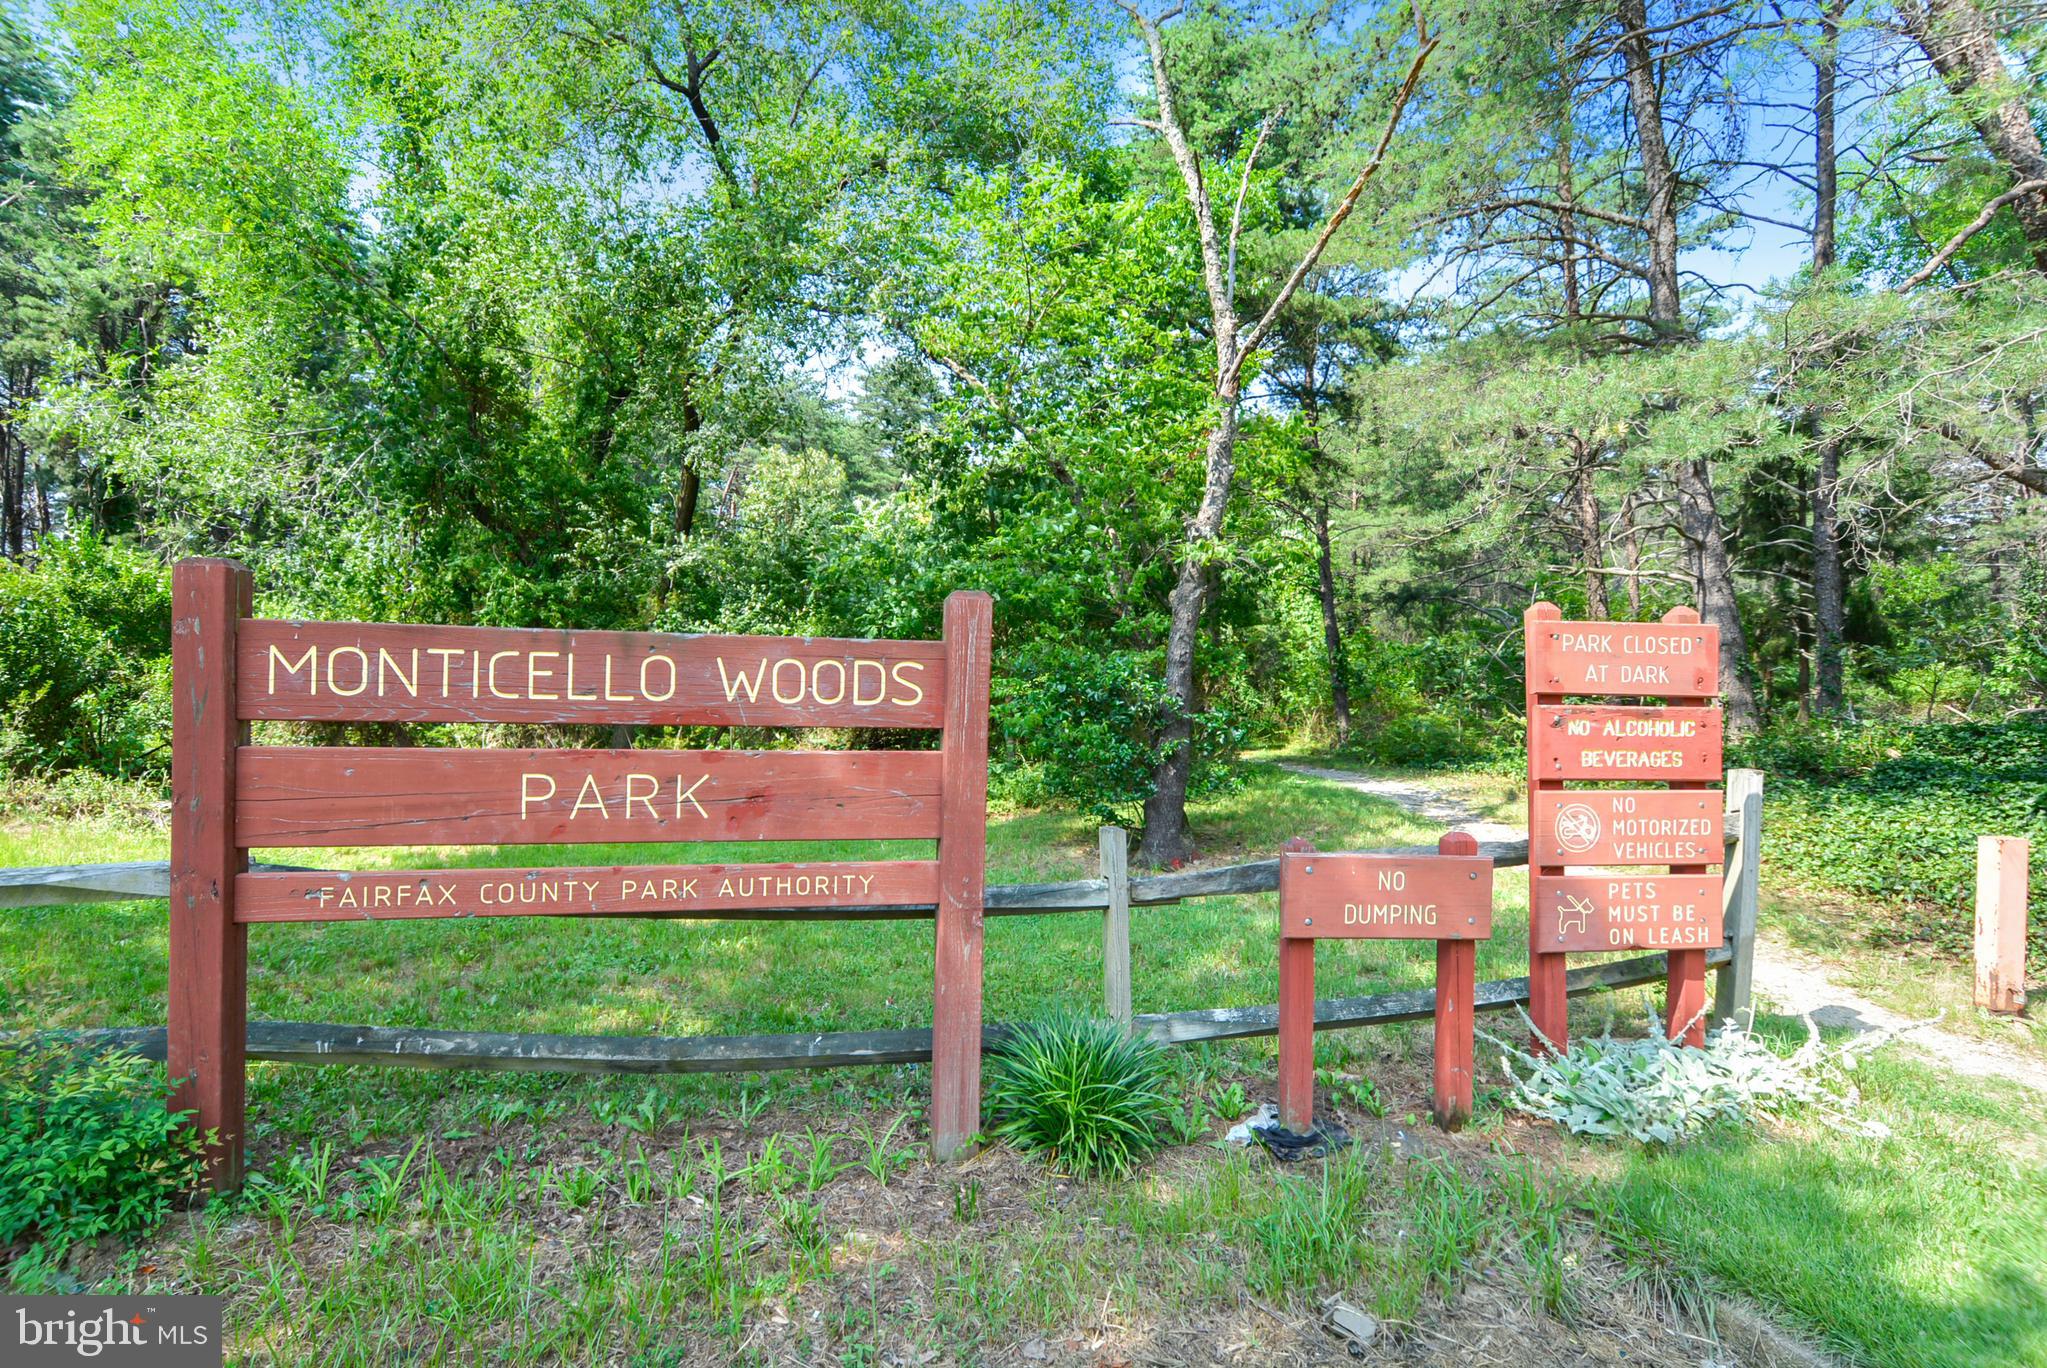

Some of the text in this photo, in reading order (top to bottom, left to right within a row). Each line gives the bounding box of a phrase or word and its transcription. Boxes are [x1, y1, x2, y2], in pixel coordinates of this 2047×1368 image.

[1561, 633, 1692, 655] PARK CLOSED
[266, 643, 925, 706] MONTICELLO WOODS
[1584, 664, 1670, 684] AT DARK
[1567, 719, 1696, 738] NO ALCOHOLIC
[1581, 750, 1683, 768] BEVERAGES
[520, 770, 710, 820] PARK
[1612, 796, 1636, 814] NO
[1612, 818, 1711, 837] MOTORIZED
[1613, 841, 1696, 860] VEHICLES
[1377, 870, 1406, 891] NO
[319, 873, 876, 909] FAIRFAX COUNTY PARK AUTHORITY
[1607, 882, 1657, 900] PETS
[1344, 904, 1437, 925] DUMPING
[1608, 904, 1696, 923] MUST BE
[1609, 926, 1709, 945] ON LEASH
